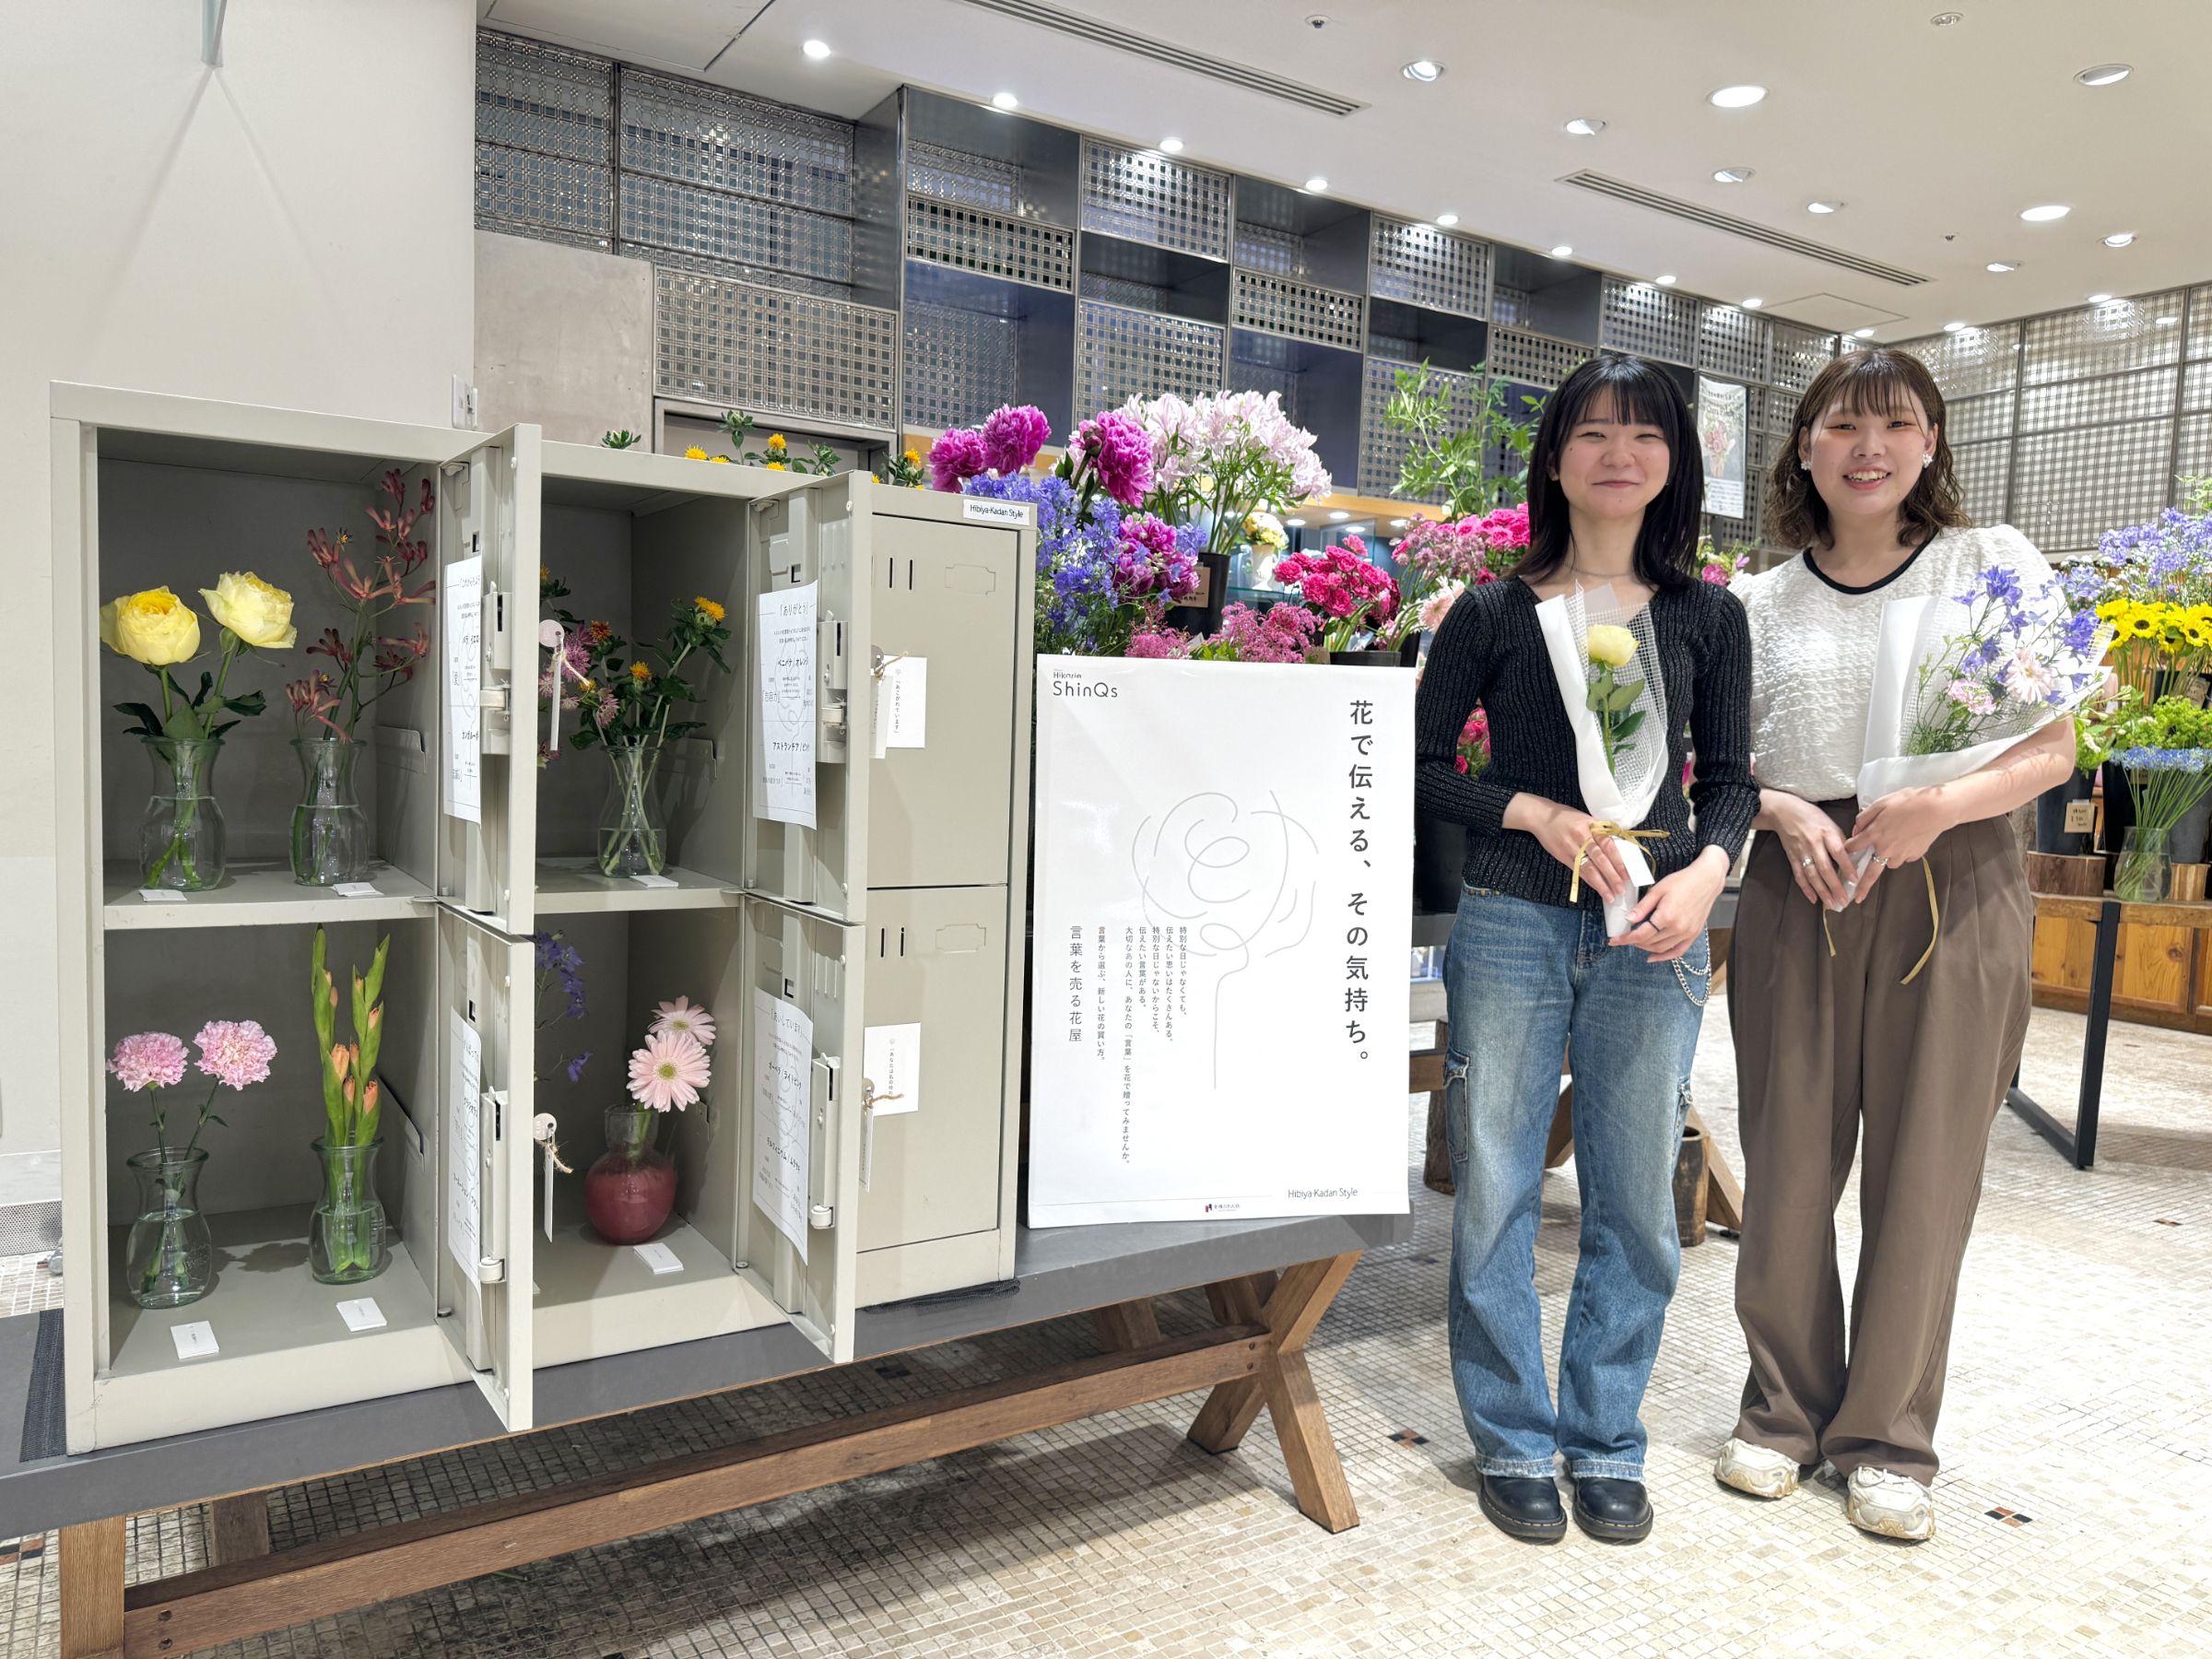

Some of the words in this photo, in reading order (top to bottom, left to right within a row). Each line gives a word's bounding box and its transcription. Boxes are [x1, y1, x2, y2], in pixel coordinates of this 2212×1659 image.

[970, 504, 1008, 516] Hibiya-Kadan
[1008, 508, 1024, 519] Style
[1053, 680, 1118, 699] ShinQs
[1345, 700, 1374, 1061] 花で伝える、その気持ち。
[1068, 925, 1083, 1042] 言葉を売る花屋
[1097, 926, 1106, 1061] 言葉から選ぶ、新しい花の買い方。
[1138, 926, 1147, 1007] 伝えたい言葉がある。
[1151, 926, 1160, 1033] 特別な日じゃないからこそ、
[1165, 926, 1173, 1041] 伝えたい思いはたくさんある。
[1179, 926, 1187, 1016] 特別な日じゃなくても、
[1122, 926, 1134, 1164] 大切なあの人に、あなたの「言葉」を花で贈ってみませんか。
[1288, 1188, 1338, 1200] Hibiya-Kadan
[1339, 1187, 1359, 1200] Style
